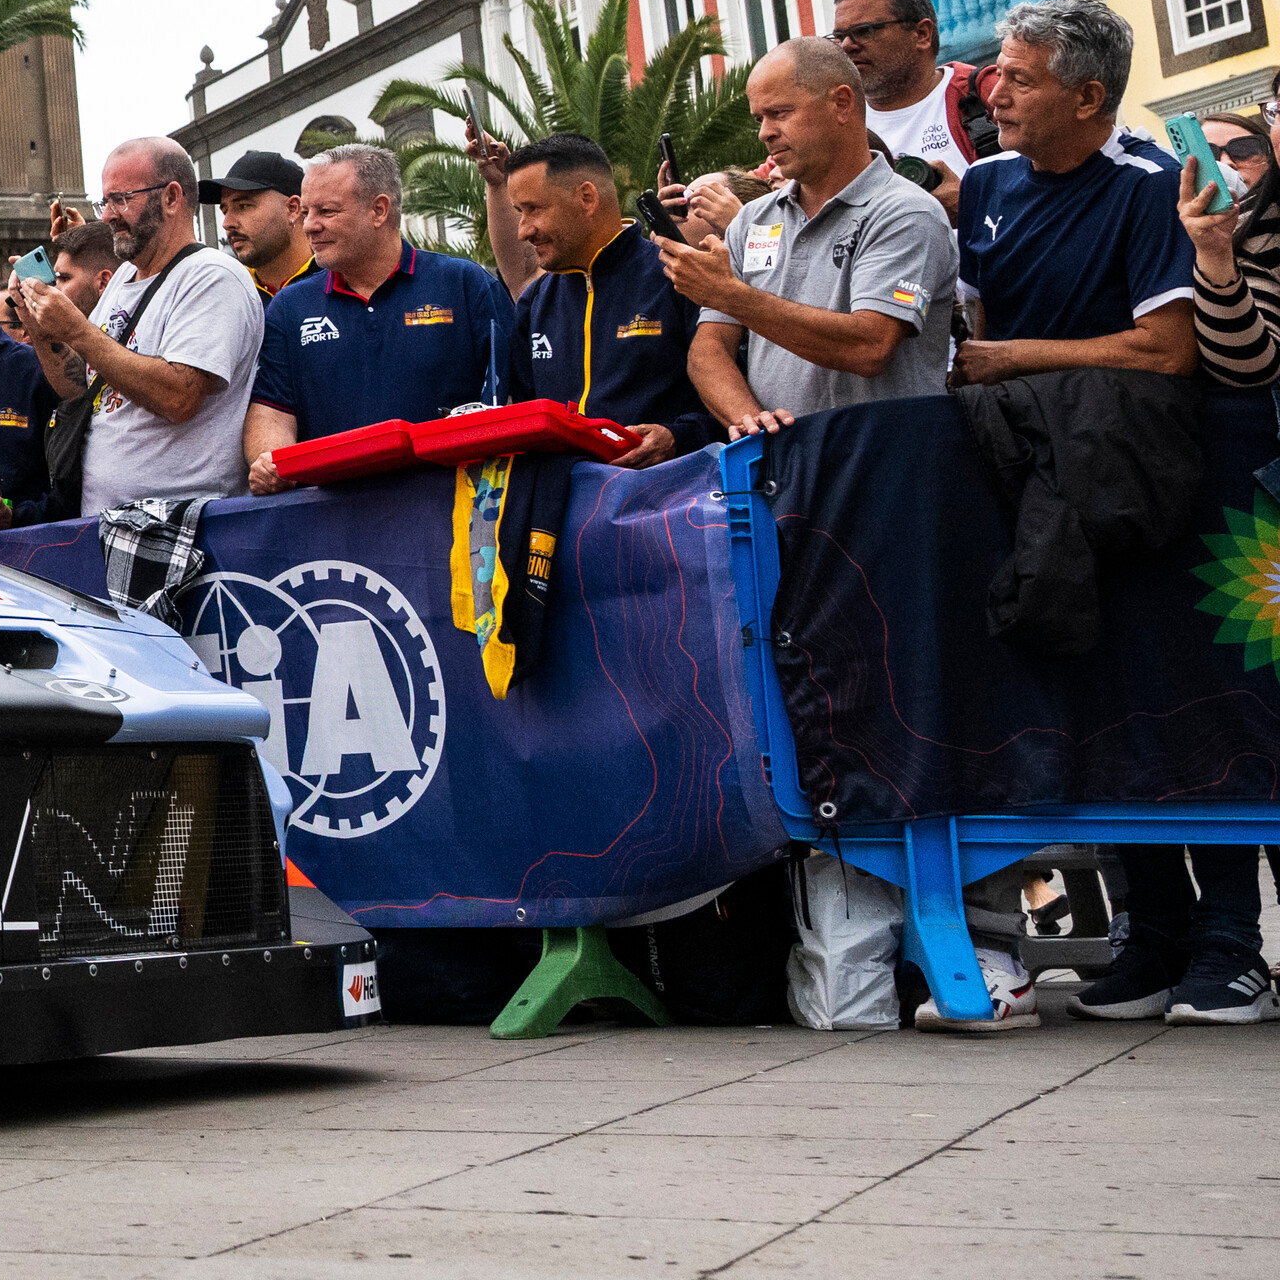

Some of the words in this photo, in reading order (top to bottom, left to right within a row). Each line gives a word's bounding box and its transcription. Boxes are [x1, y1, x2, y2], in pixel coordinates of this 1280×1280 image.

[747, 240, 779, 250] BOSCH
[765, 255, 772, 267] A
[300, 317, 338, 337] EA
[300, 331, 340, 346] SPORTS
